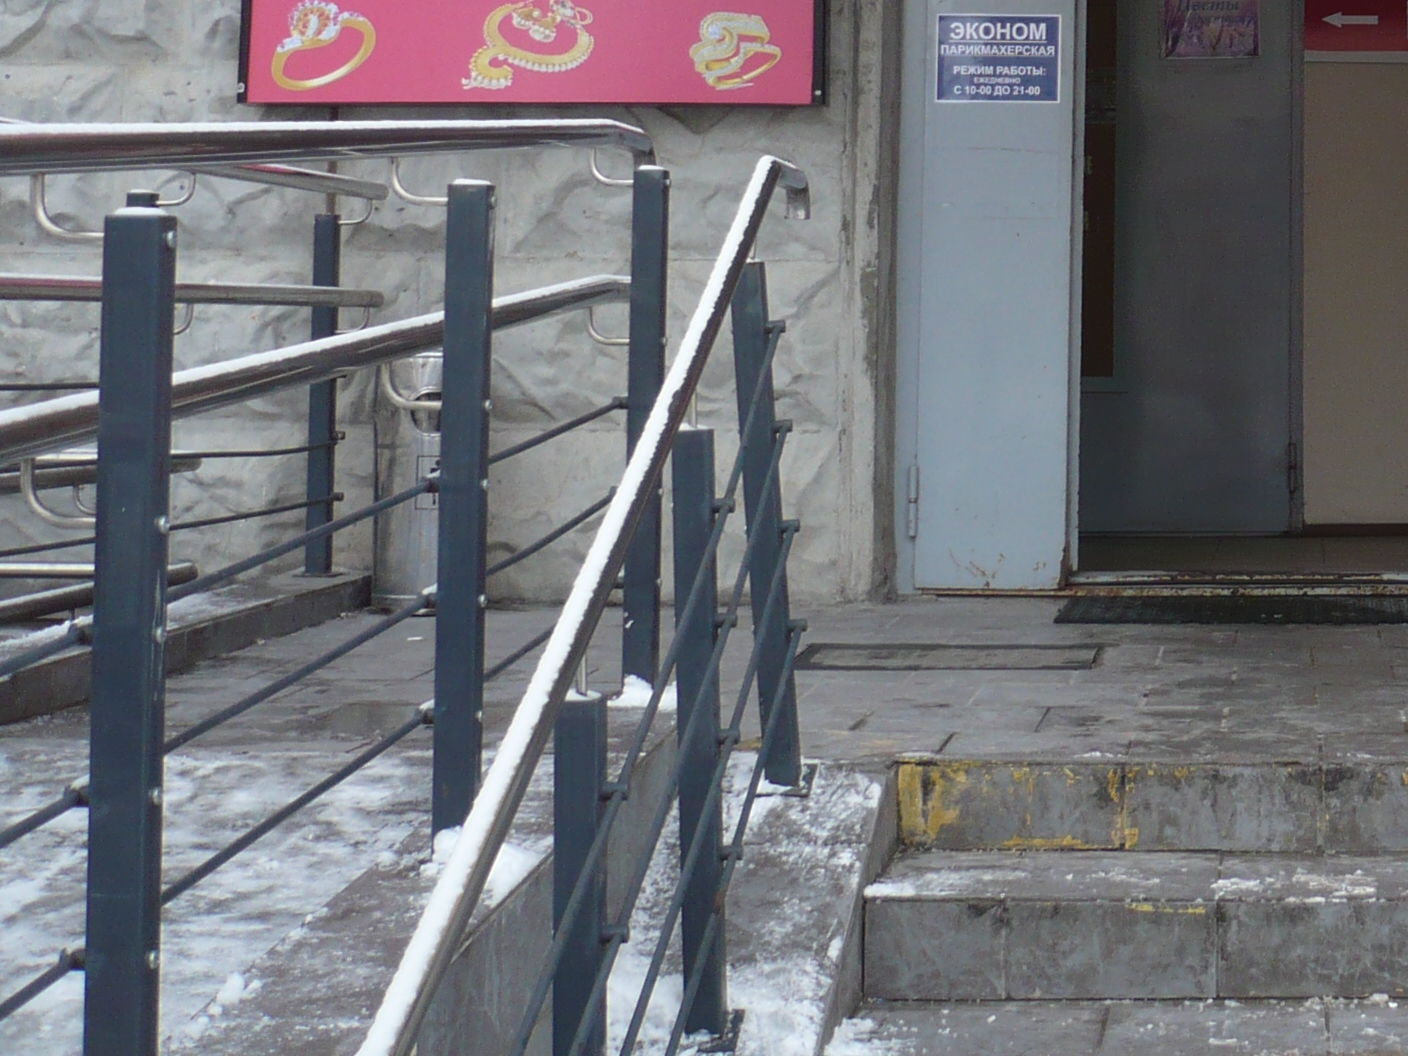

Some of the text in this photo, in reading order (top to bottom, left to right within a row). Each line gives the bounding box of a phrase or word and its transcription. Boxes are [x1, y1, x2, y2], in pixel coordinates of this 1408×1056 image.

[950, 22, 1046, 40] ЭКОНОМ
[941, 44, 1055, 56] ПАРИКМАХЕРСКАЯ
[953, 66, 1046, 76] РЕЖИМ РАБОТЫ:
[954, 86, 1040, 97] С 10-00 ДО 21-00
